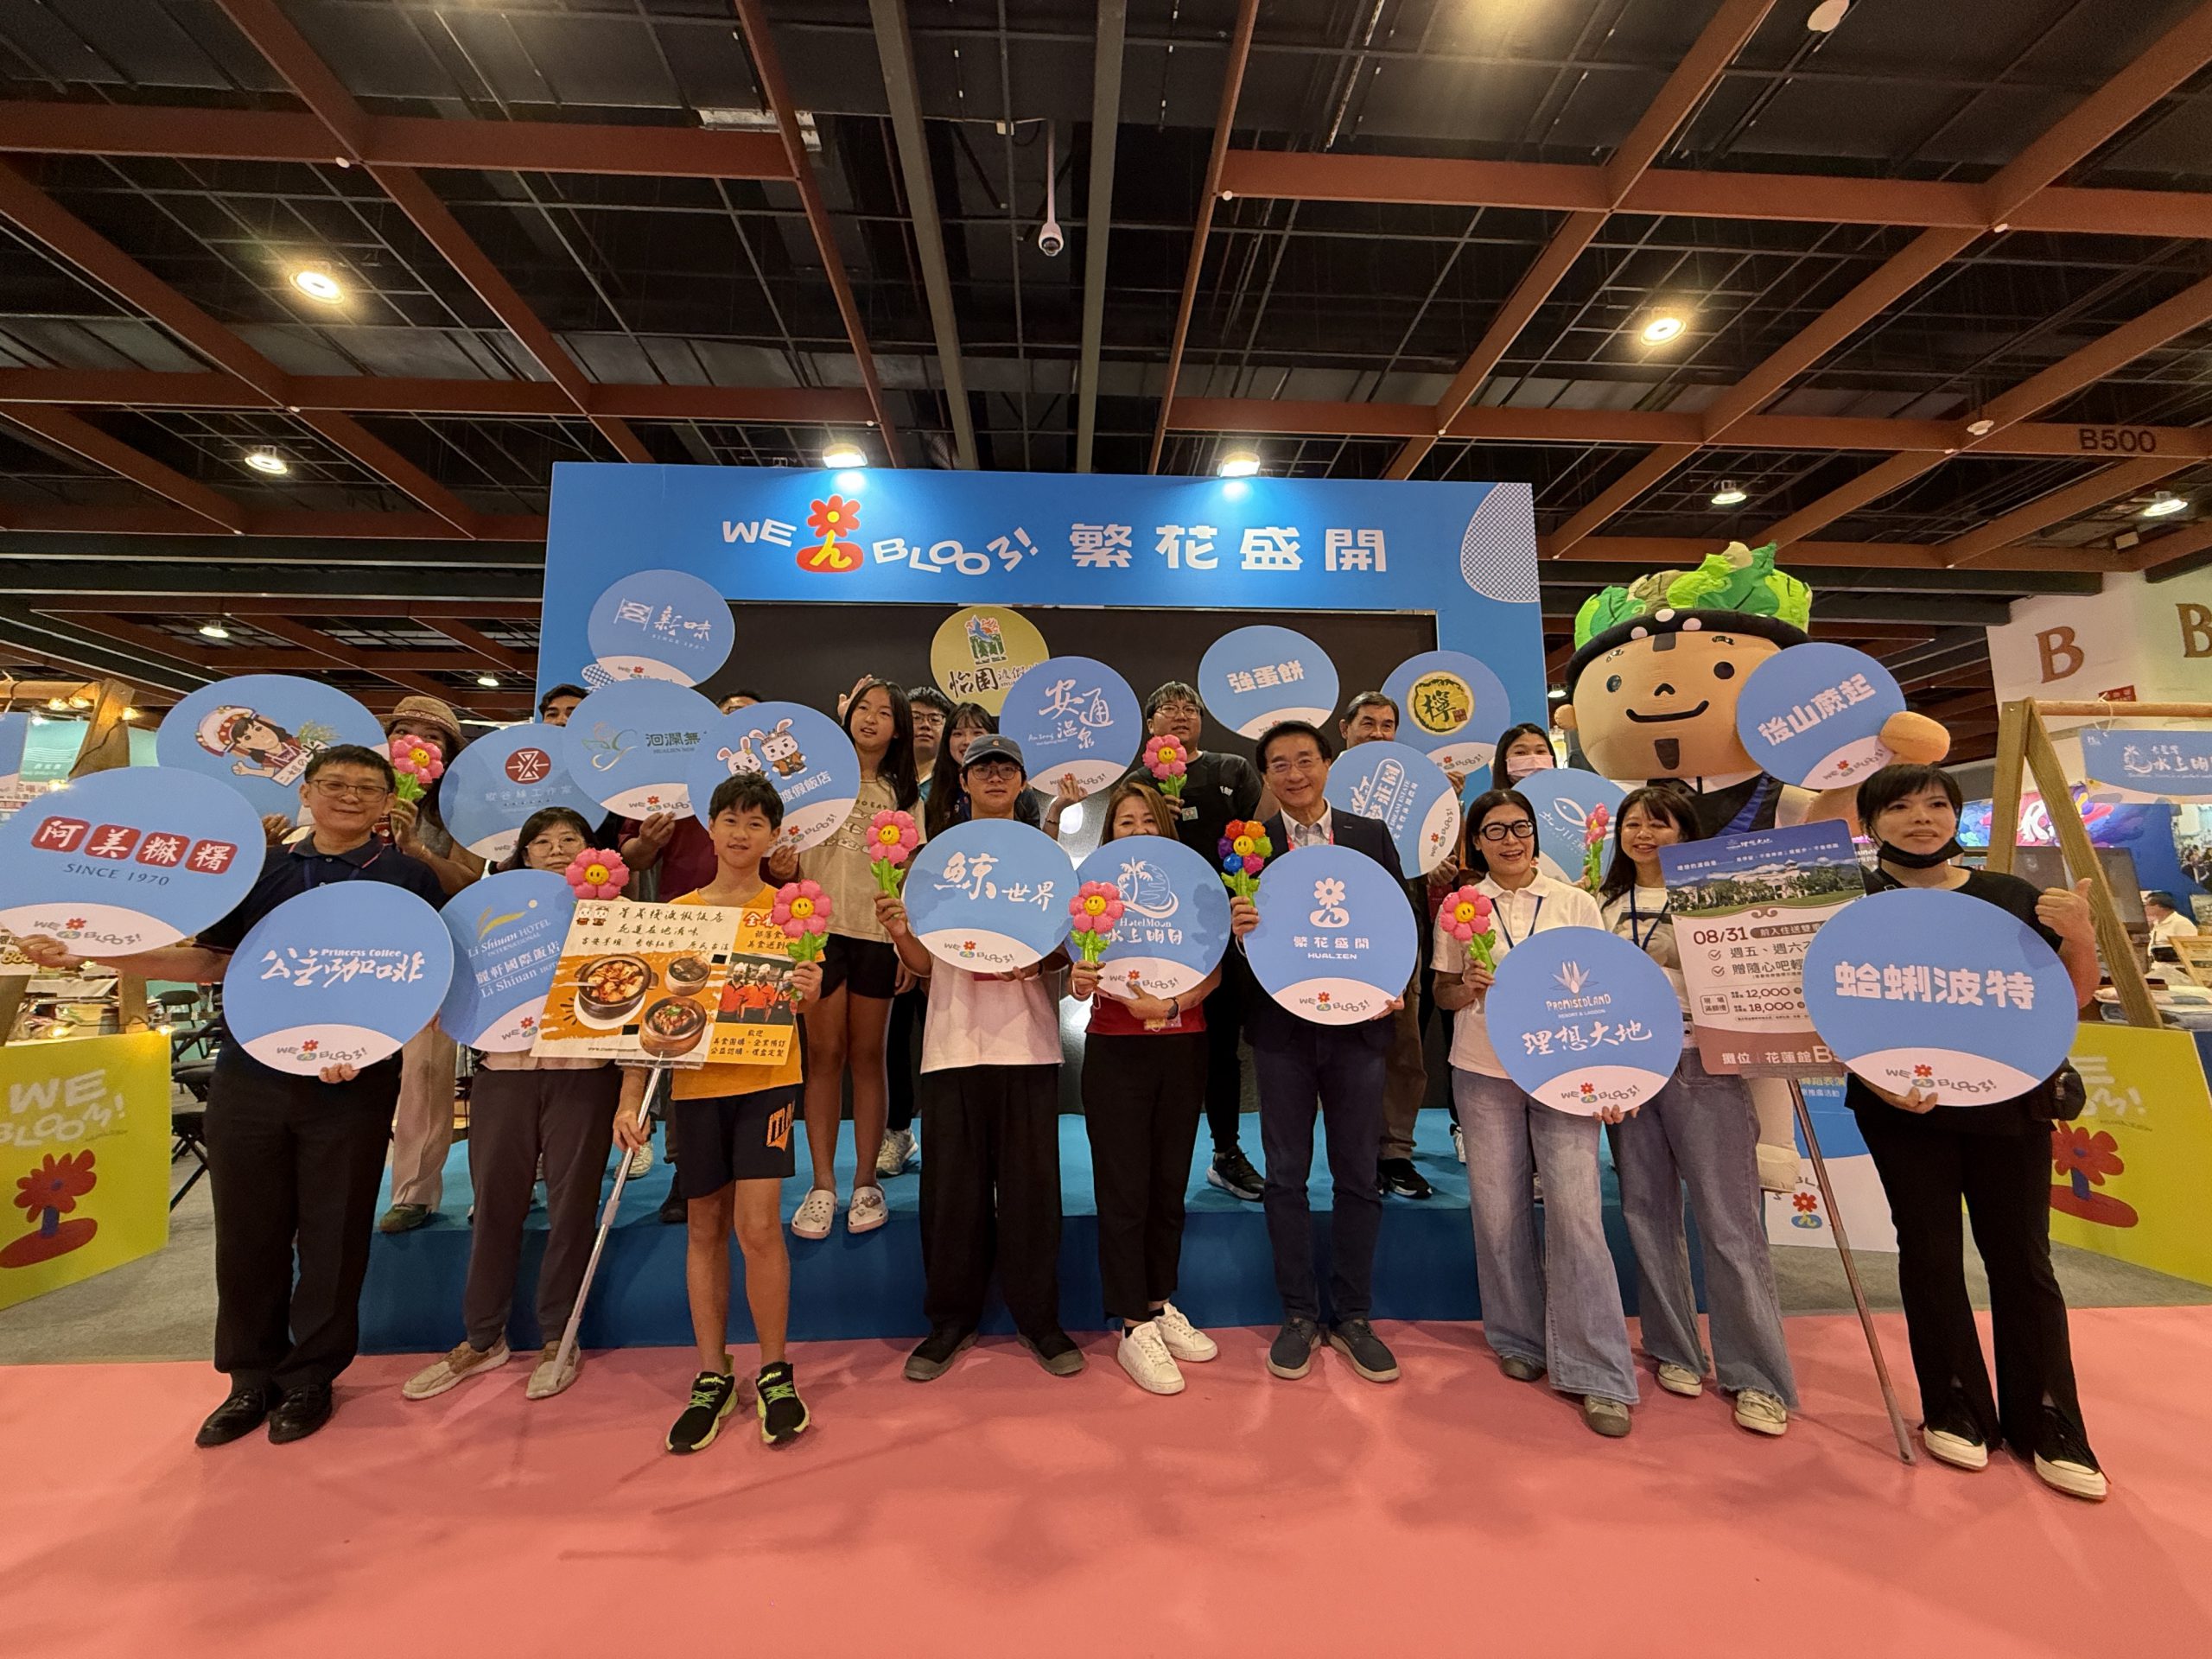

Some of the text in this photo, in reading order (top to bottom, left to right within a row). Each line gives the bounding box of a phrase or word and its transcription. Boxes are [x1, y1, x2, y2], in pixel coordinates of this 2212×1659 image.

[2079, 429, 2157, 454] B500
[722, 518, 797, 548] WE
[1069, 523, 1387, 572] 繁花盛開
[2175, 602, 2212, 658] B
[2035, 626, 2085, 683] B
[1226, 660, 1306, 694] 強蛋餅
[645, 731, 707, 747] 洄瀾無
[1822, 769, 1840, 780] WE
[63, 863, 169, 887] SINCE 1970
[34, 920, 61, 931] WE
[1693, 926, 1749, 945] 08/31
[468, 944, 479, 959] Li
[519, 918, 551, 938] HOTEL
[944, 942, 960, 950] WE
[1293, 935, 1370, 950] 繁花盛開
[320, 948, 402, 957] Princess Coffee
[260, 947, 426, 988] 公主咖啡
[480, 984, 494, 999] Li
[496, 968, 537, 992] Shiuan
[1745, 987, 1790, 1000] 12,000
[1834, 961, 2035, 1010] 蛤蜊波特
[1749, 1001, 1795, 1014] 18,000
[501, 1028, 520, 1040] WE
[1522, 1019, 1653, 1055] 理想大地
[276, 1046, 299, 1055] WE
[1885, 1068, 1912, 1078] WE
[10, 1069, 106, 1115] WE
[1560, 1090, 1580, 1099] WE
